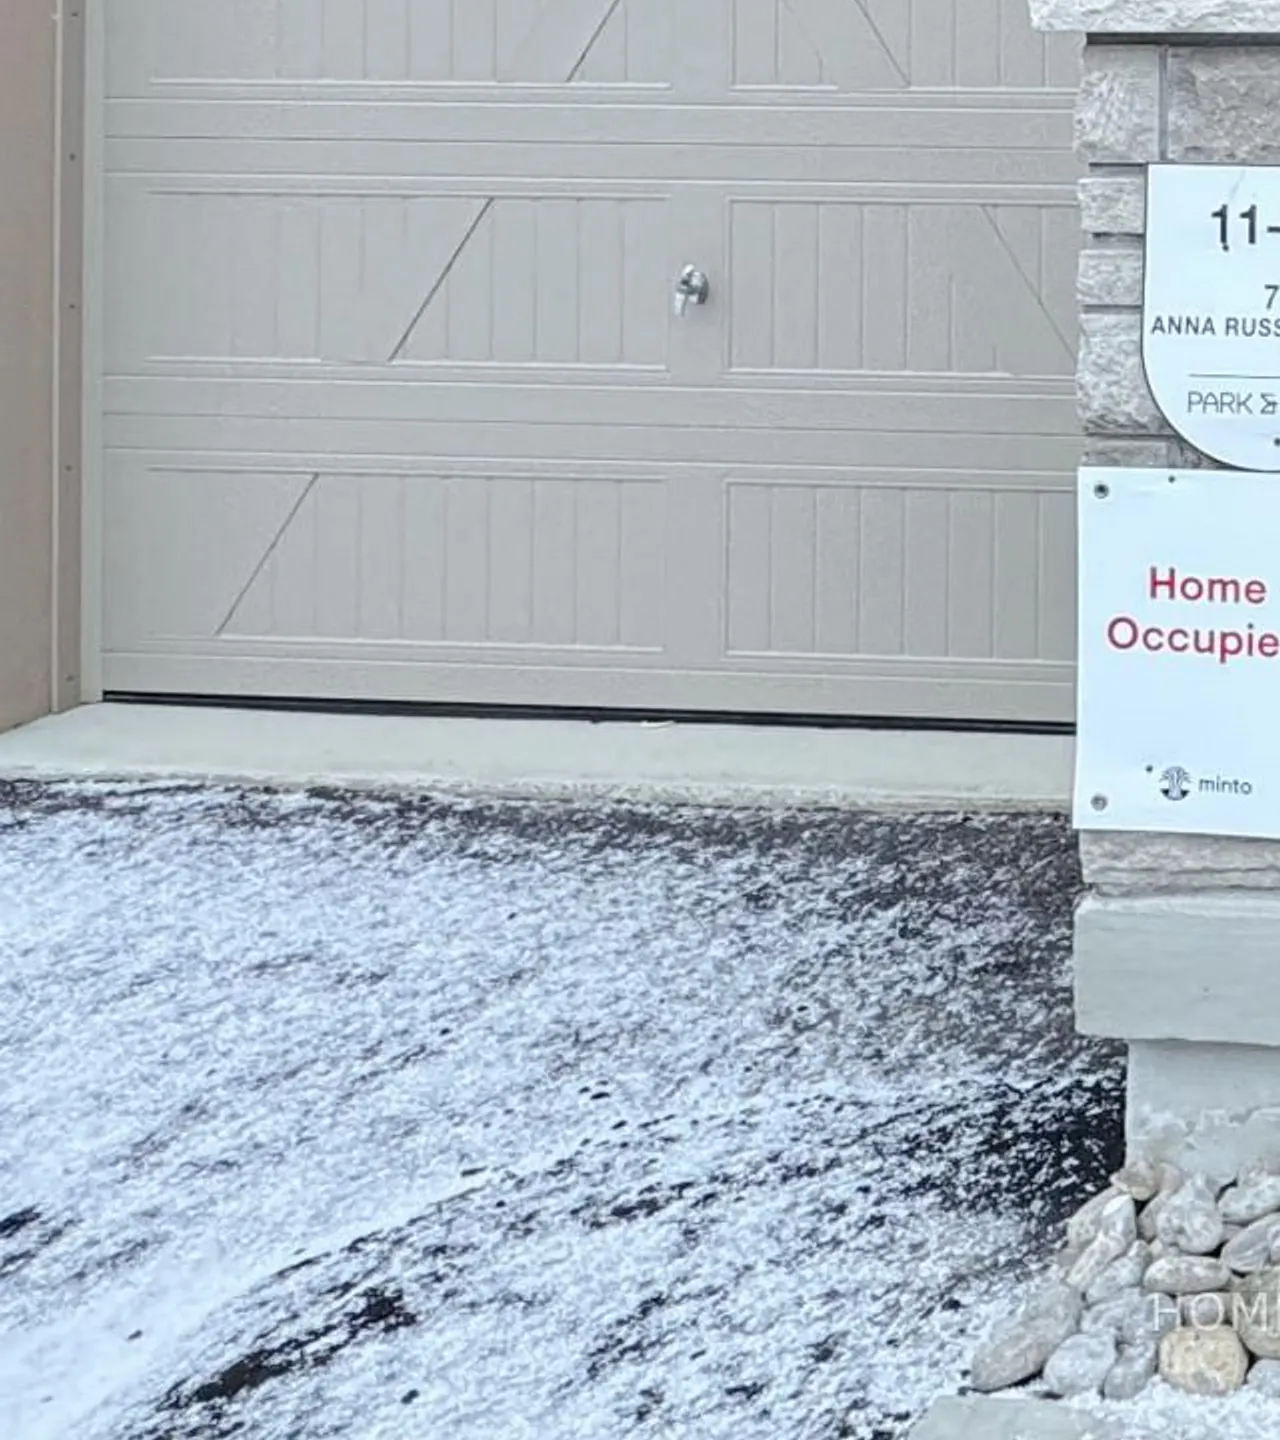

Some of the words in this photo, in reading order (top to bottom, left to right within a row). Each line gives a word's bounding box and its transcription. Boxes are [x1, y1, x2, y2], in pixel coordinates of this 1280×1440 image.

[1264, 284, 1280, 310] 7
[1151, 315, 1216, 336] ANNA
[1187, 391, 1254, 415] PARK
[1149, 566, 1268, 604] Home
[1198, 776, 1253, 796] minto
